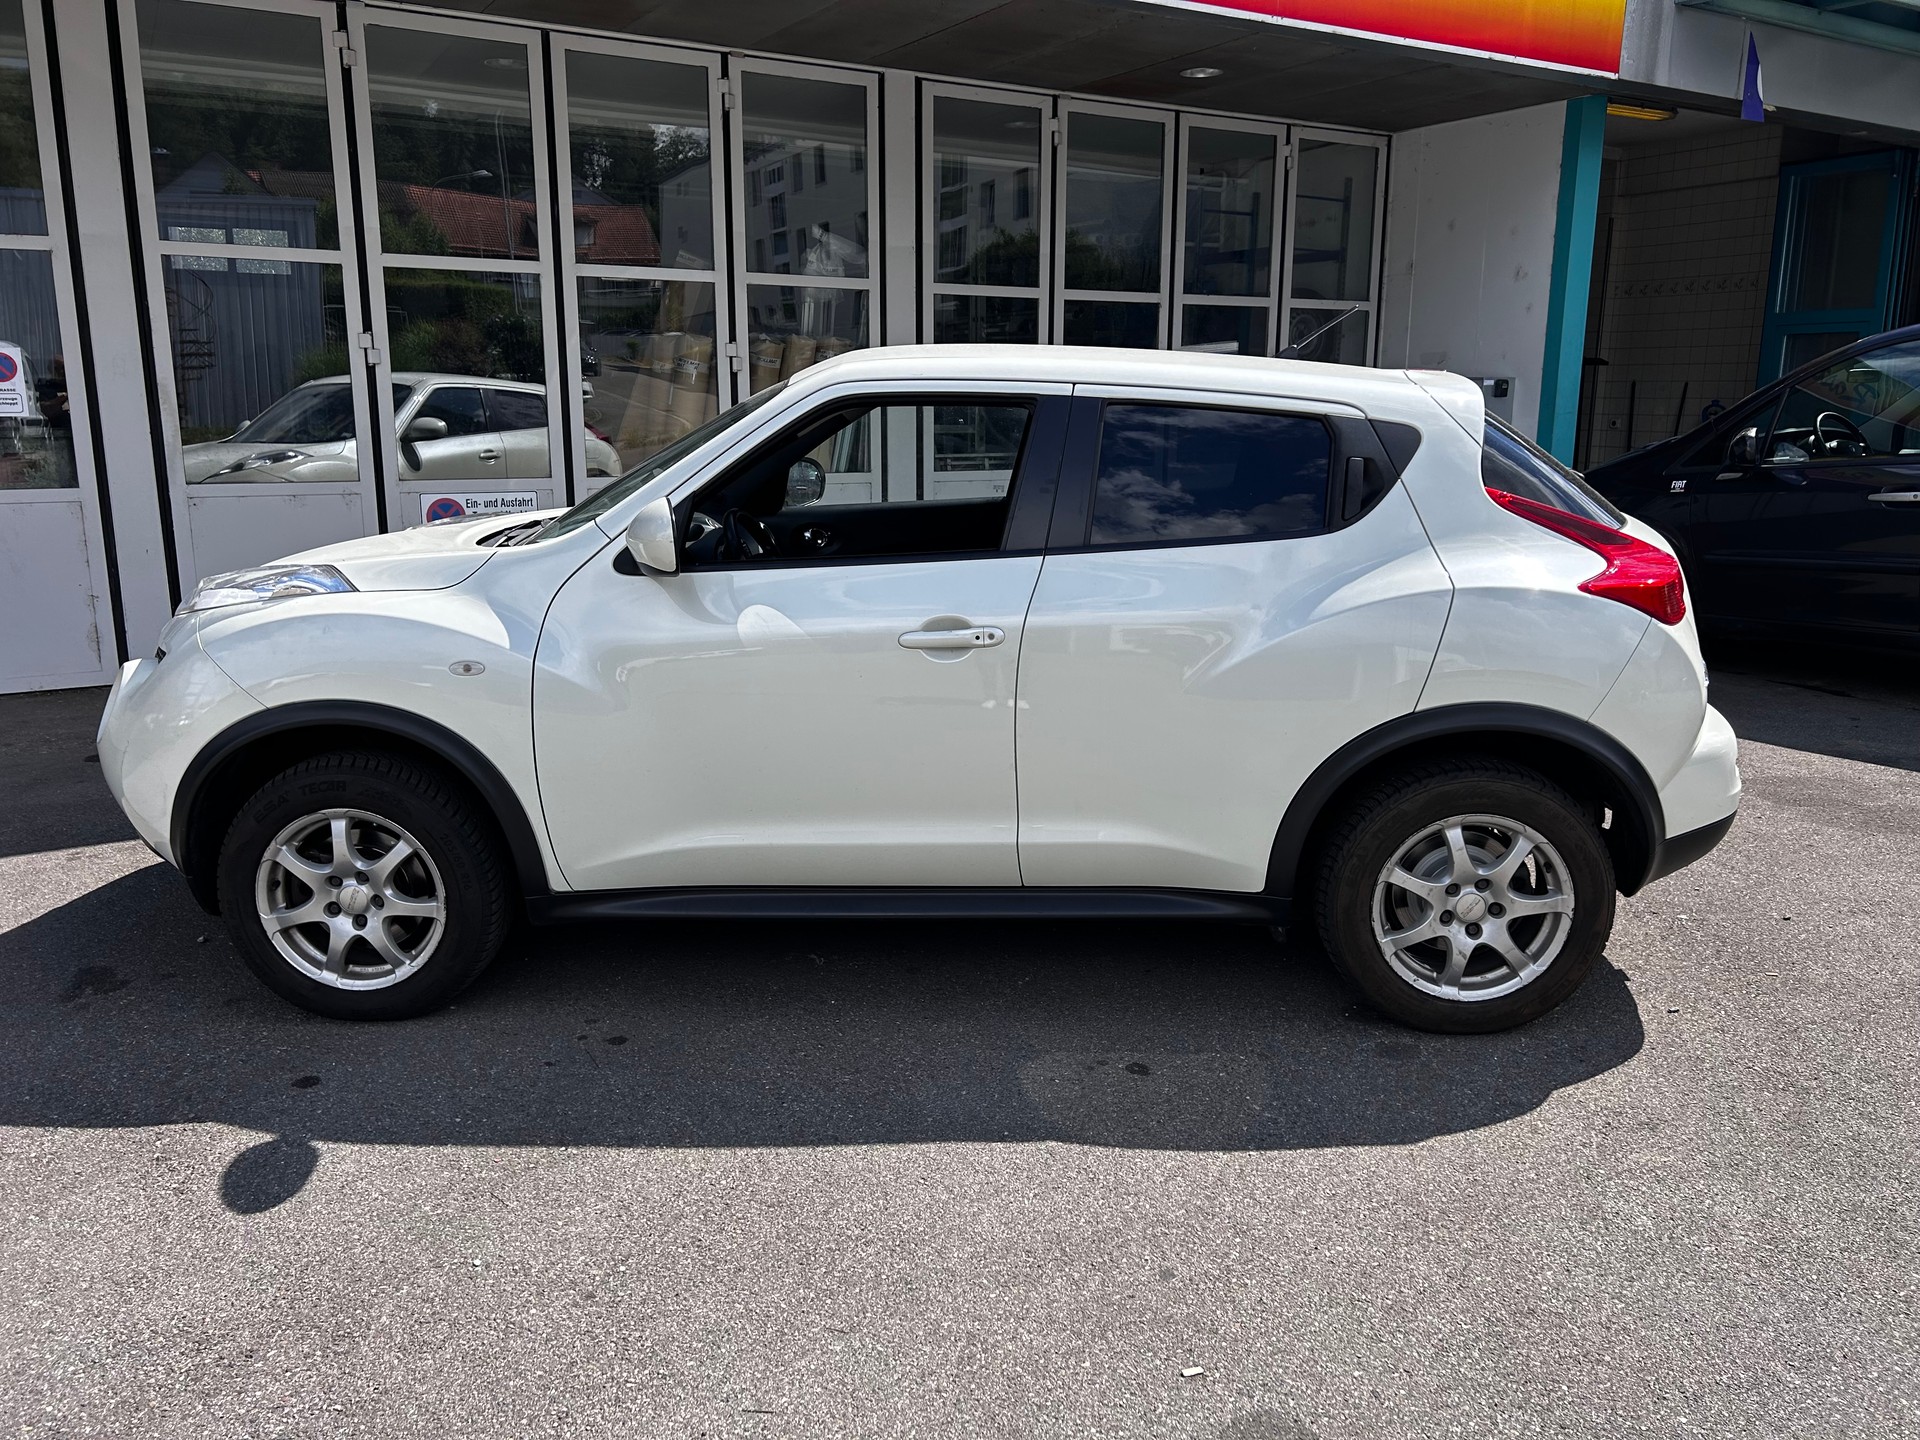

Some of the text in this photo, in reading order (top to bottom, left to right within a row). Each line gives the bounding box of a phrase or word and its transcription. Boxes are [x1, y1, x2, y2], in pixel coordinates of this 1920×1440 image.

[1671, 480, 1687, 489] FIAT
[466, 497, 533, 508] Ein- und Ausfahrt
[298, 780, 346, 796] TECAR
